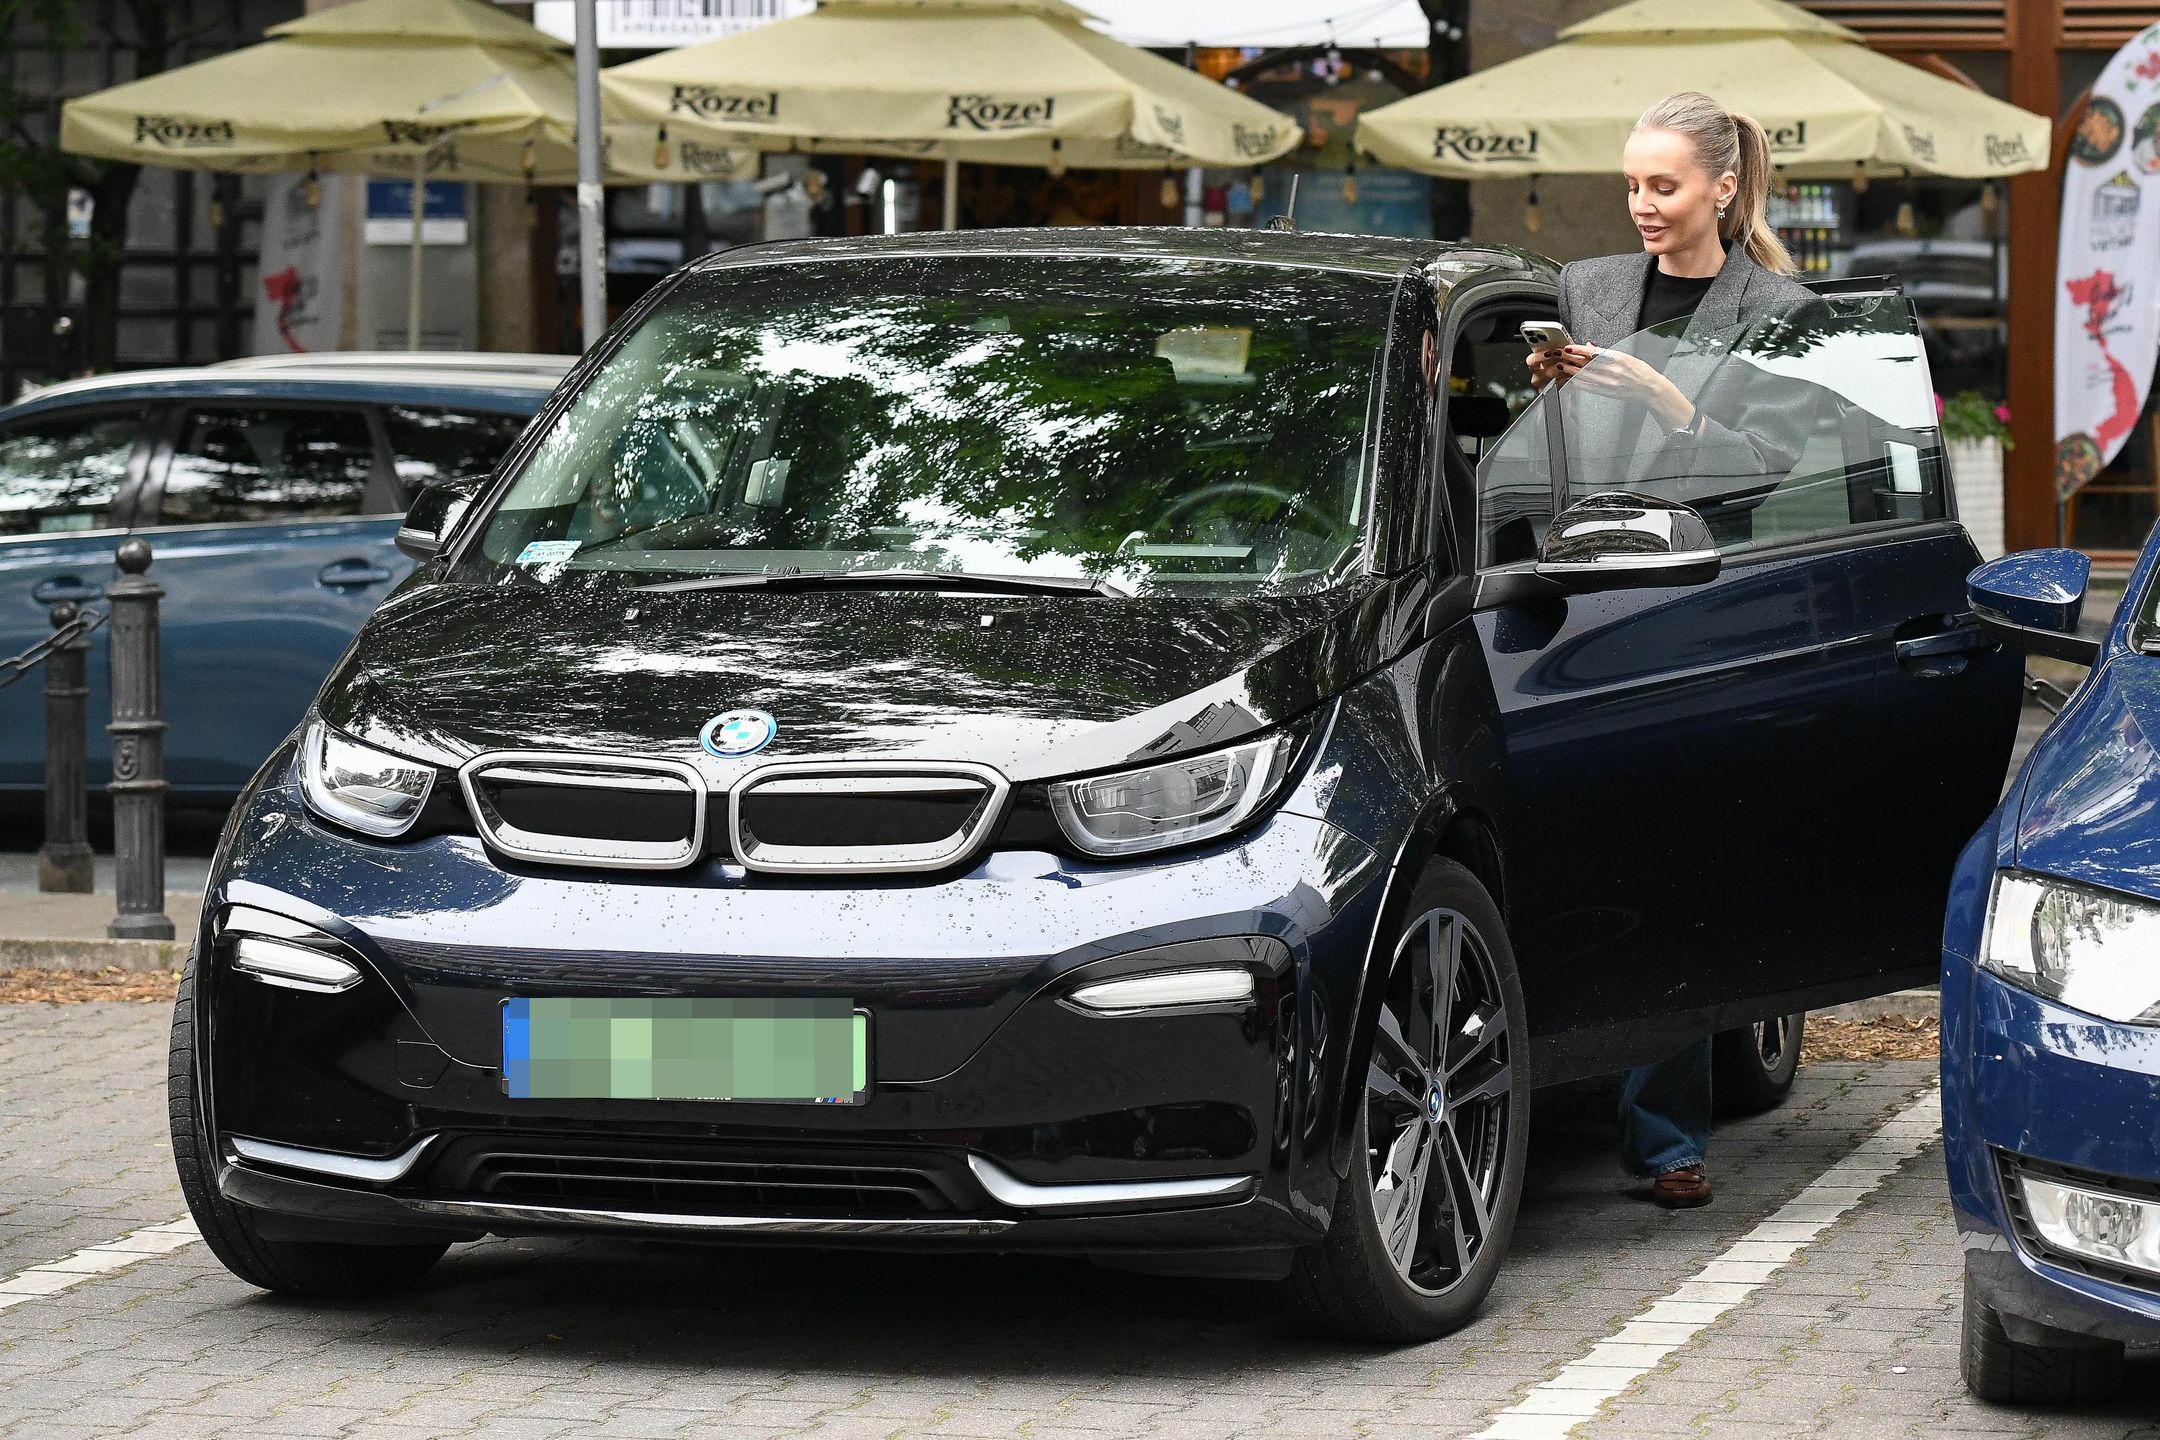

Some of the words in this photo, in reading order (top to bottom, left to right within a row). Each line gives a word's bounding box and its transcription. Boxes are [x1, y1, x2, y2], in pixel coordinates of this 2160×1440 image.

[671, 84, 778, 120] Kozel
[947, 94, 1055, 131] Kozel
[135, 115, 236, 147] Kozel
[1434, 127, 1539, 162] Kozel
